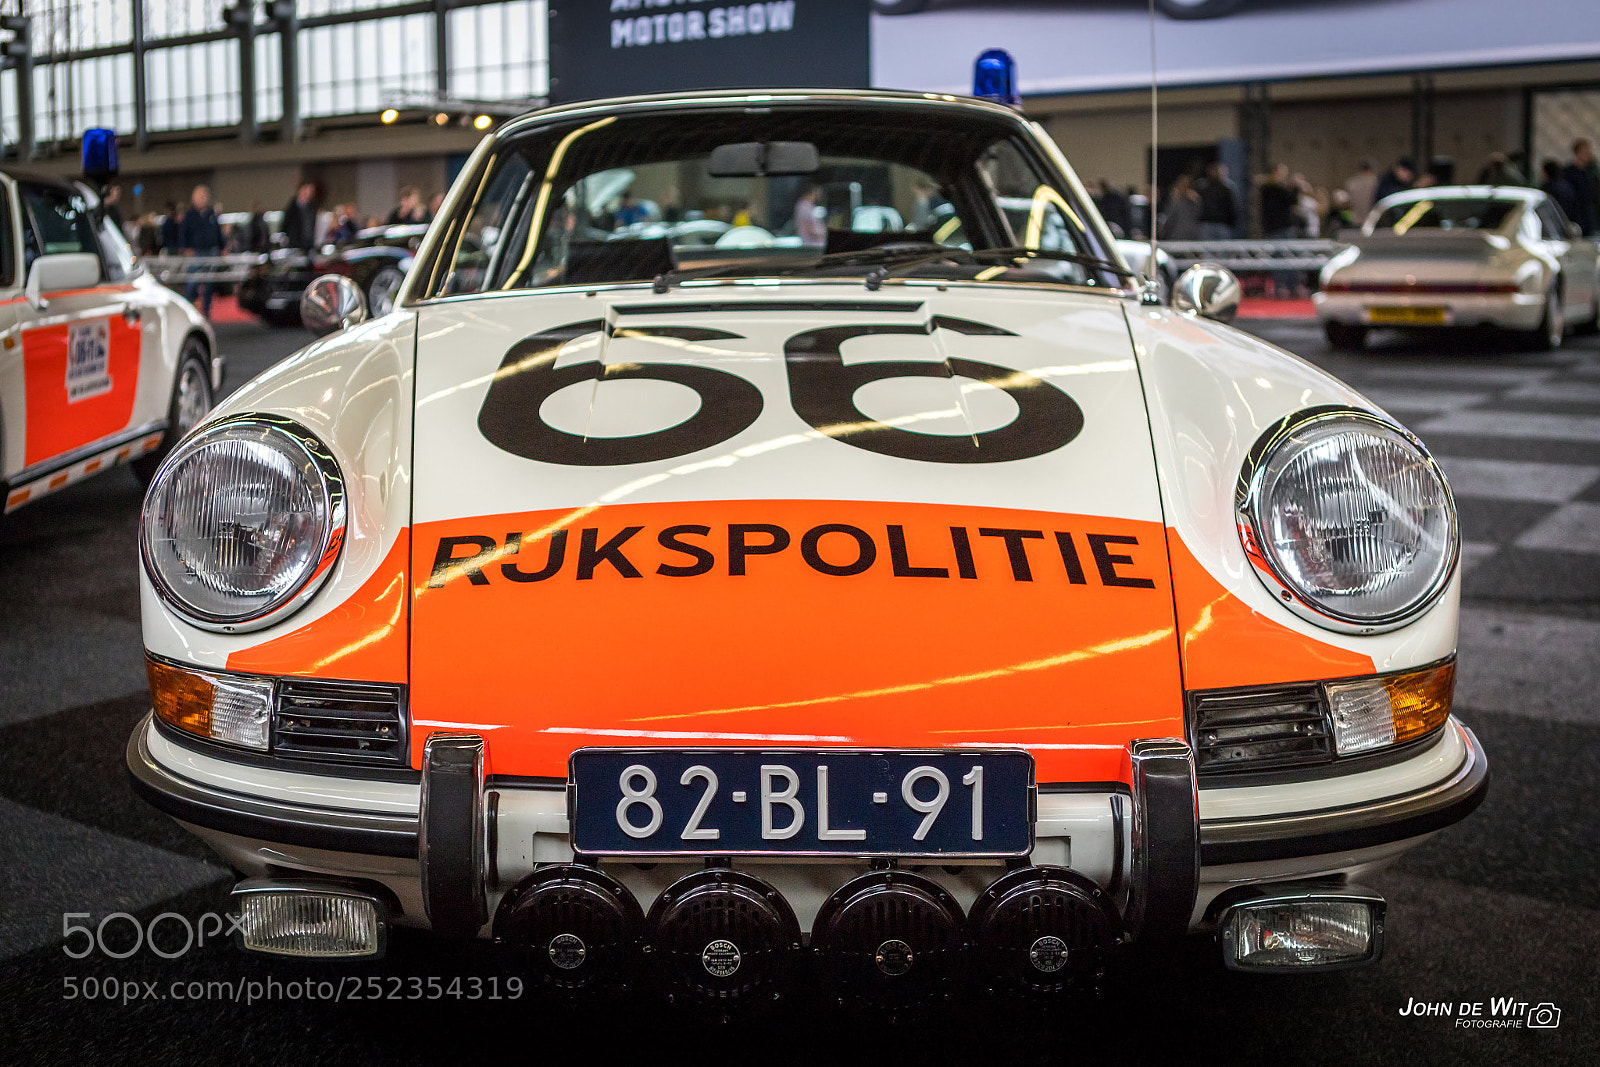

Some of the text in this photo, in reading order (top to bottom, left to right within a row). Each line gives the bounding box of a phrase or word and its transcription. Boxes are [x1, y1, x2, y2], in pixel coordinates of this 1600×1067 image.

[477, 316, 1085, 466] 66
[615, 764, 984, 842] 82-BL-91
[709, 942, 732, 951] BOSCH
[1038, 938, 1061, 947] BOSCH
